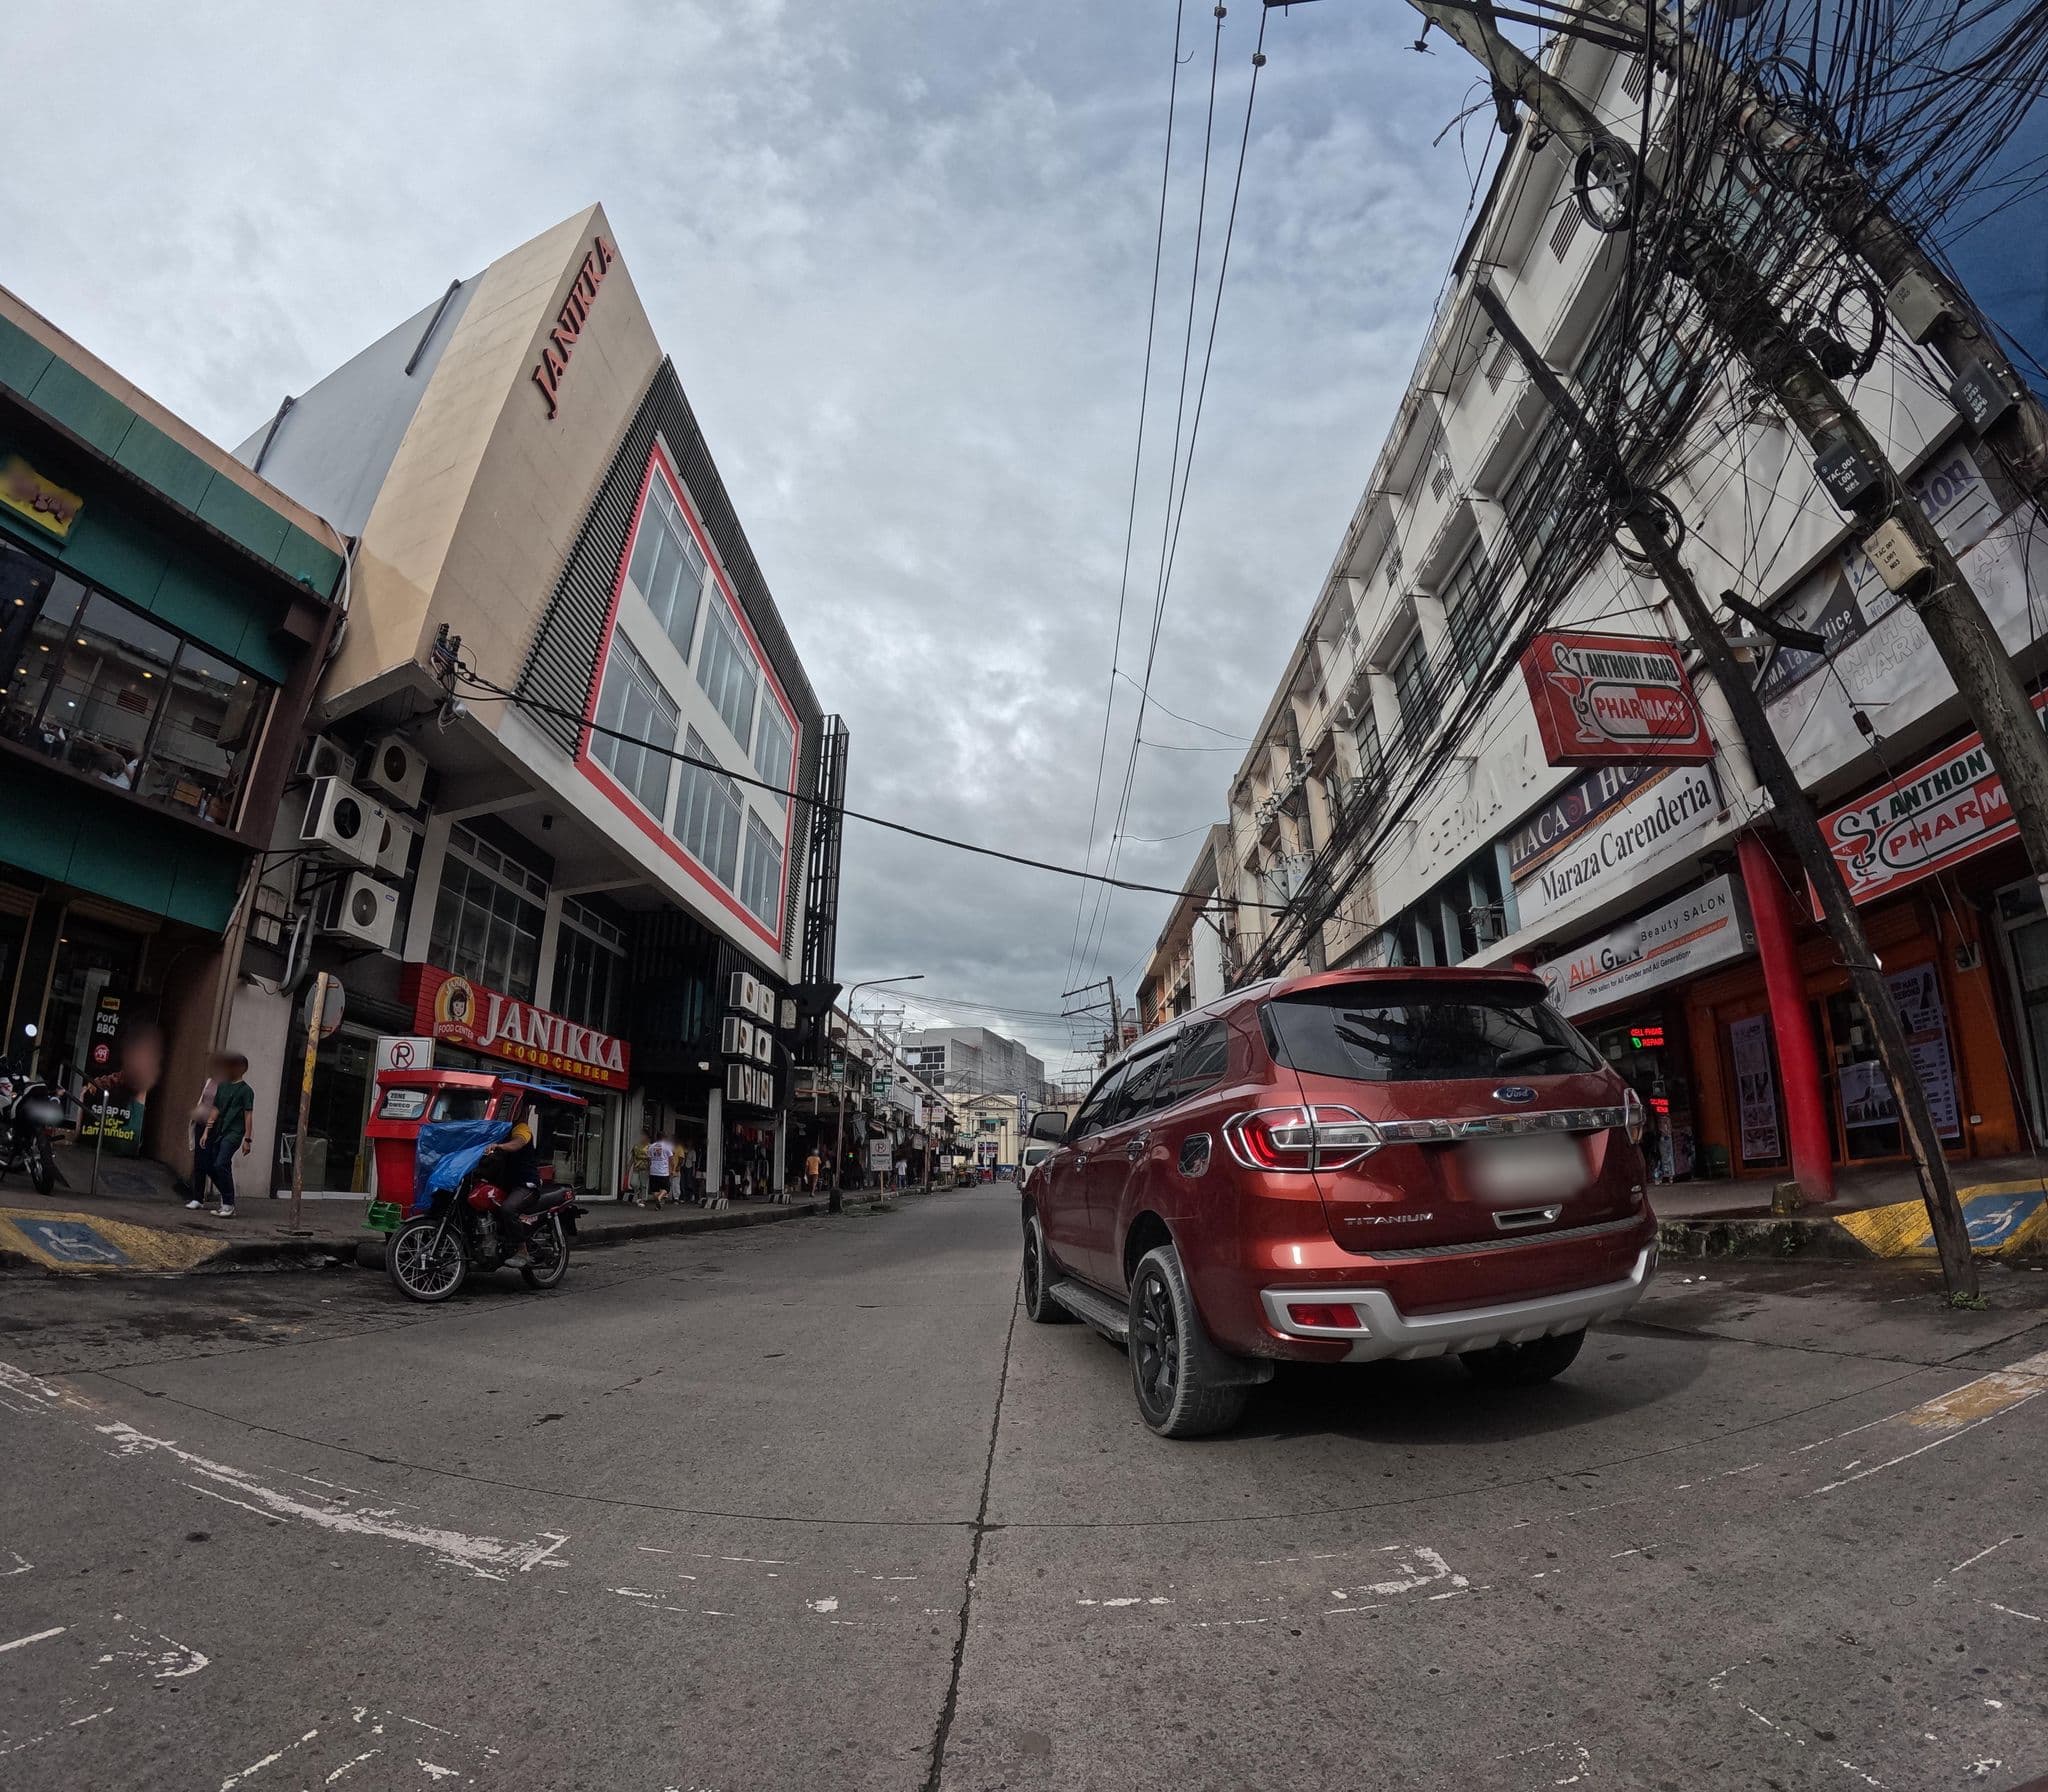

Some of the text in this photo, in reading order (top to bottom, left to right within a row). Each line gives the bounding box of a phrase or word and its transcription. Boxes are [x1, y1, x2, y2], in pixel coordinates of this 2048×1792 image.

[532, 236, 615, 420] JANIKKA
[1588, 653, 1646, 680] ANTHONY
[1645, 656, 1682, 682] ABAD
[1593, 697, 1686, 721] PHARMACY
[1888, 748, 1988, 819] ANTHON
[1888, 784, 2009, 858] PHARM
[1541, 852, 1601, 907] Maraza
[1600, 775, 1712, 868] Carenderia
[1641, 916, 1679, 942] Beauty
[1683, 893, 1726, 922] SALON
[96, 1023, 116, 1036] BBQ
[97, 1012, 120, 1025] Pork
[476, 993, 626, 1073] JANIKKA
[503, 1040, 610, 1082] FOOD CENTER
[92, 1104, 118, 1117] Saap
[1506, 1088, 1530, 1099] Ford
[1344, 1212, 1434, 1226] TITANIUM
